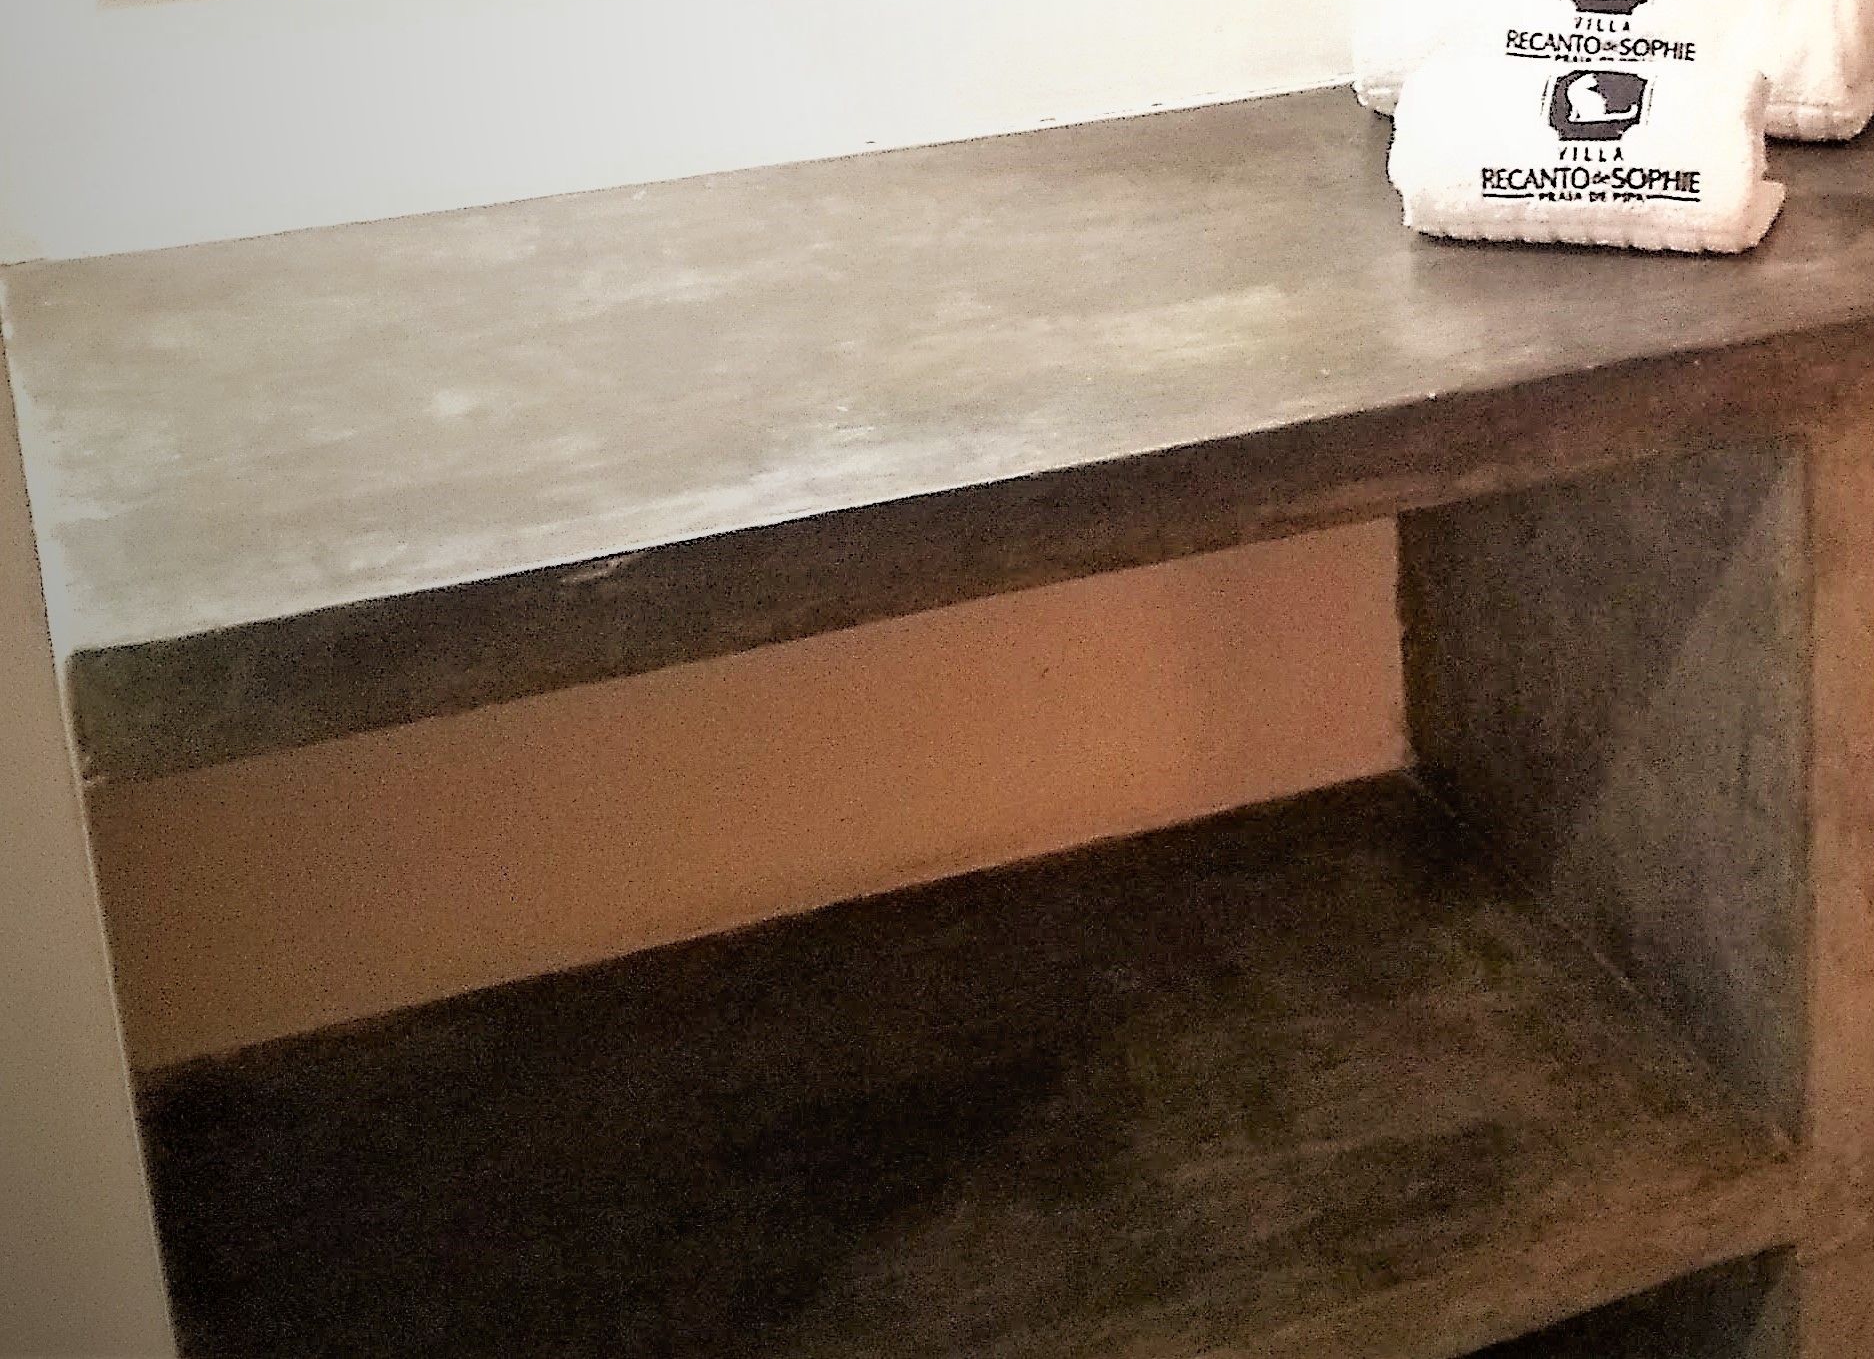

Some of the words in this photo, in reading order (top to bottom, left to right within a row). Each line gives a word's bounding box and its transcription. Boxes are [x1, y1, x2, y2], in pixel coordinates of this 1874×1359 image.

[1574, 16, 1631, 32] VILLA
[1506, 29, 1601, 54] RECANTO
[1618, 38, 1697, 61] SOPHIE
[1559, 146, 1624, 162] VILLA
[1481, 167, 1590, 190] RECANTO
[1611, 167, 1701, 193] SOPHIE
